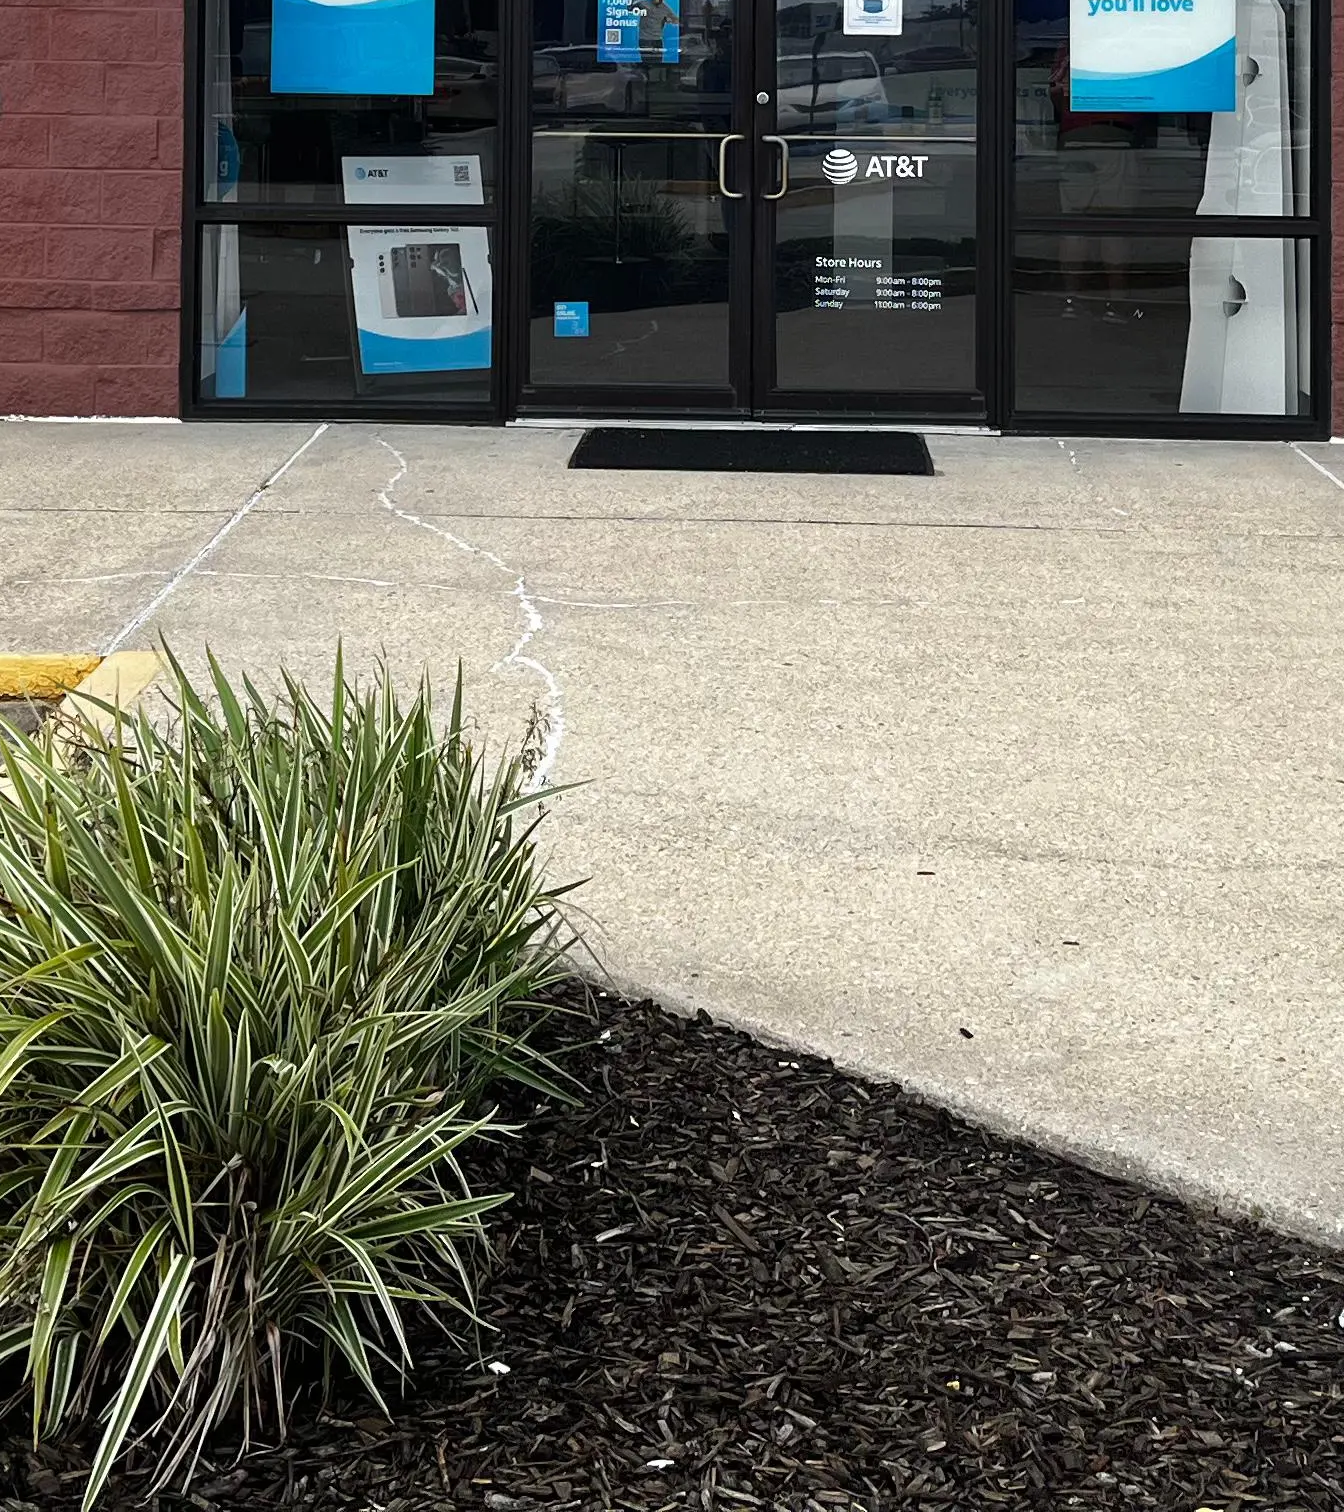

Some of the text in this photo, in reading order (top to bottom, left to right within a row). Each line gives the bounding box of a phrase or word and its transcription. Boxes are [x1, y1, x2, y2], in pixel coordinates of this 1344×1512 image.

[606, 7, 647, 17] Sign-On
[606, 18, 637, 26] Bonus
[865, 155, 928, 178] AT&T
[368, 169, 388, 178] AT&T
[815, 256, 882, 268] Store Hours
[815, 275, 845, 284] Mon-Fri
[876, 277, 906, 285] 9:00am
[815, 288, 850, 298] Saturday
[815, 299, 843, 309] Sunday
